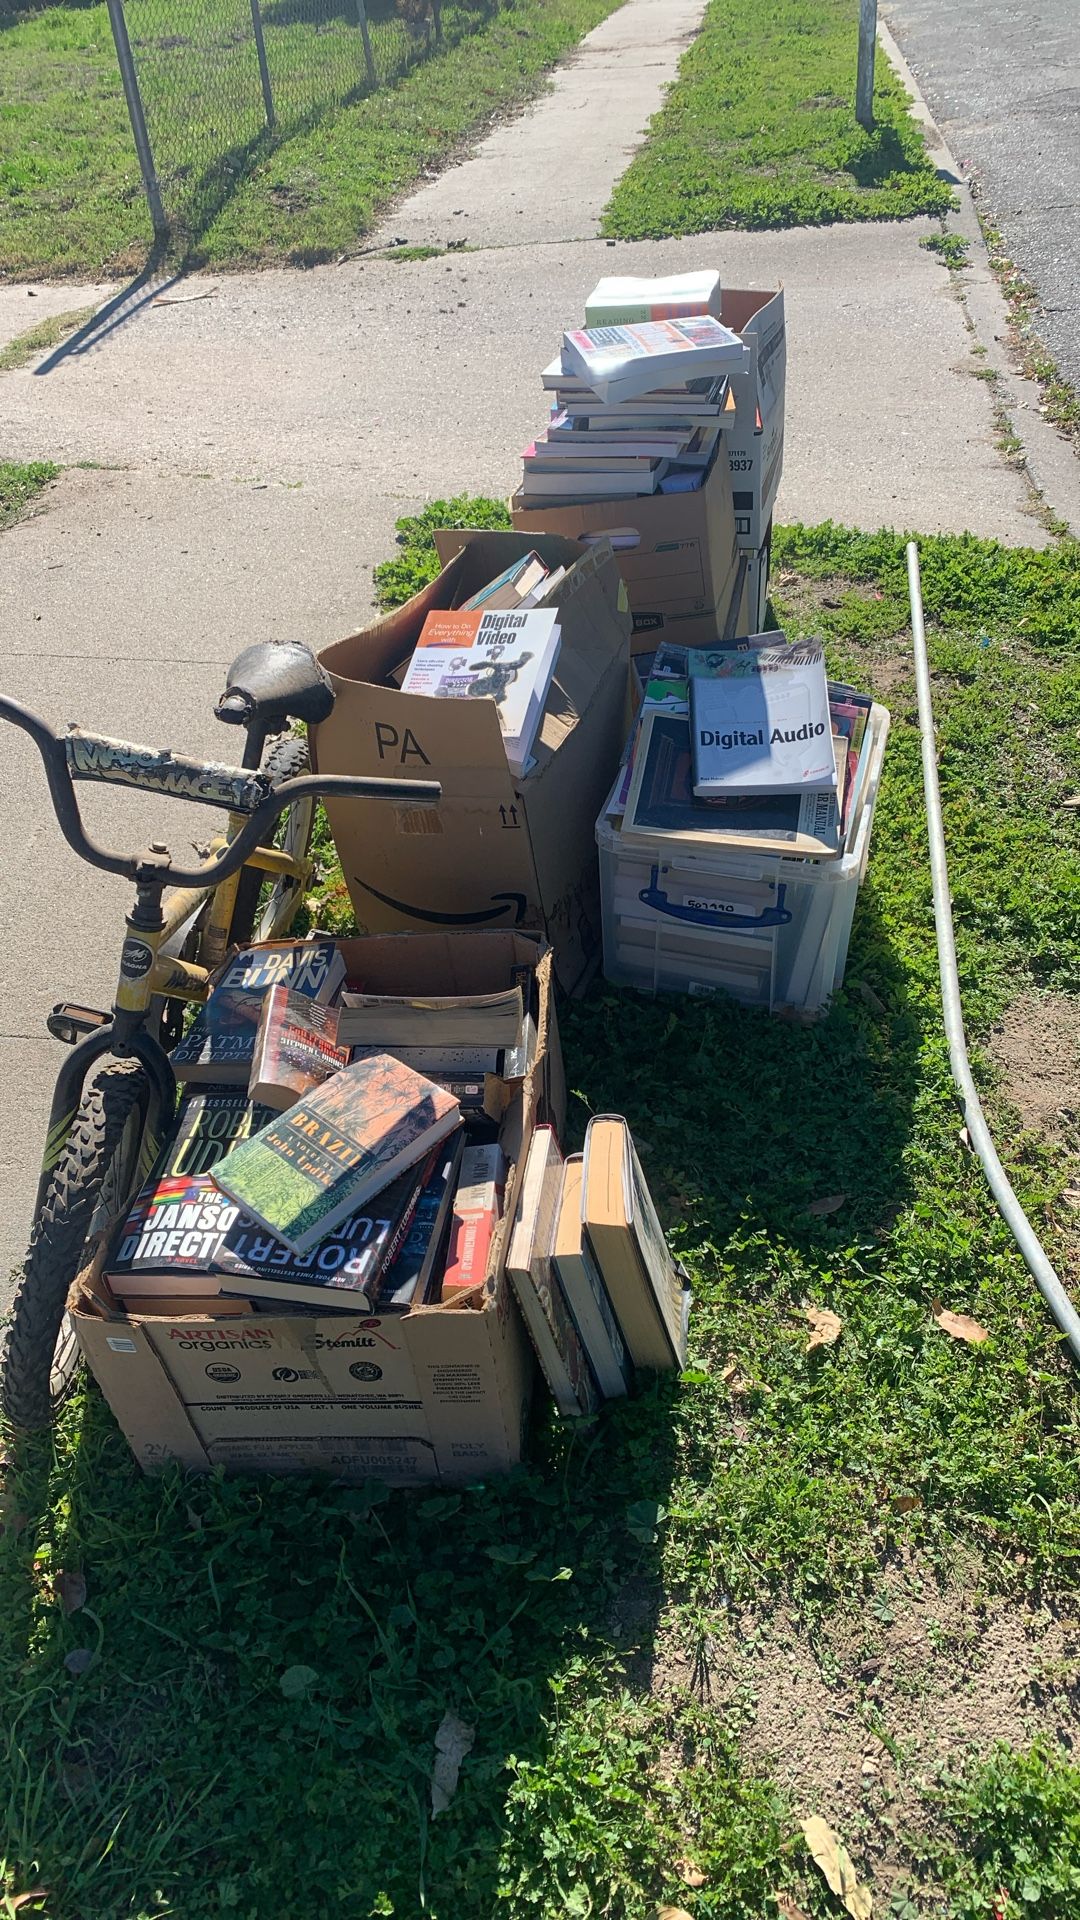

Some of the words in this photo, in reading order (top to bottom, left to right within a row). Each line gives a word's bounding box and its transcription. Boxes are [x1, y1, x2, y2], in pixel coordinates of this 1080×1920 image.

[428, 629, 475, 638] Everything
[481, 613, 528, 631] Digital
[476, 632, 517, 646] Video
[373, 721, 431, 765] PA
[700, 729, 764, 750] Digital
[770, 722, 825, 745] Audio
[814, 803, 828, 836] MANUAL
[263, 949, 328, 970] DAVIS
[221, 966, 328, 990] BUNN
[182, 1034, 257, 1049] PATM
[174, 1050, 252, 1061] DECEPTI
[189, 1109, 279, 1140] ROBER
[289, 1112, 364, 1170] BRAZIL
[296, 1141, 321, 1164] NOVEL
[155, 1139, 236, 1179] LUD
[266, 1132, 295, 1158] John
[296, 1155, 337, 1188] Updike
[472, 1161, 488, 1178] AYN
[196, 1191, 224, 1205] THE
[143, 1205, 240, 1231] JANSO
[115, 1230, 228, 1263] DIRECTI
[224, 1233, 373, 1275] ROBERT
[381, 1234, 402, 1275] ROBERT
[460, 1226, 478, 1271] FOUNTAINHEAD
[173, 1256, 199, 1264] NOVEL
[256, 1266, 295, 1277] BESTSELLING
[166, 1328, 275, 1340] ARTISAN
[178, 1339, 272, 1352] organics
[302, 1332, 377, 1350] Stemilt
